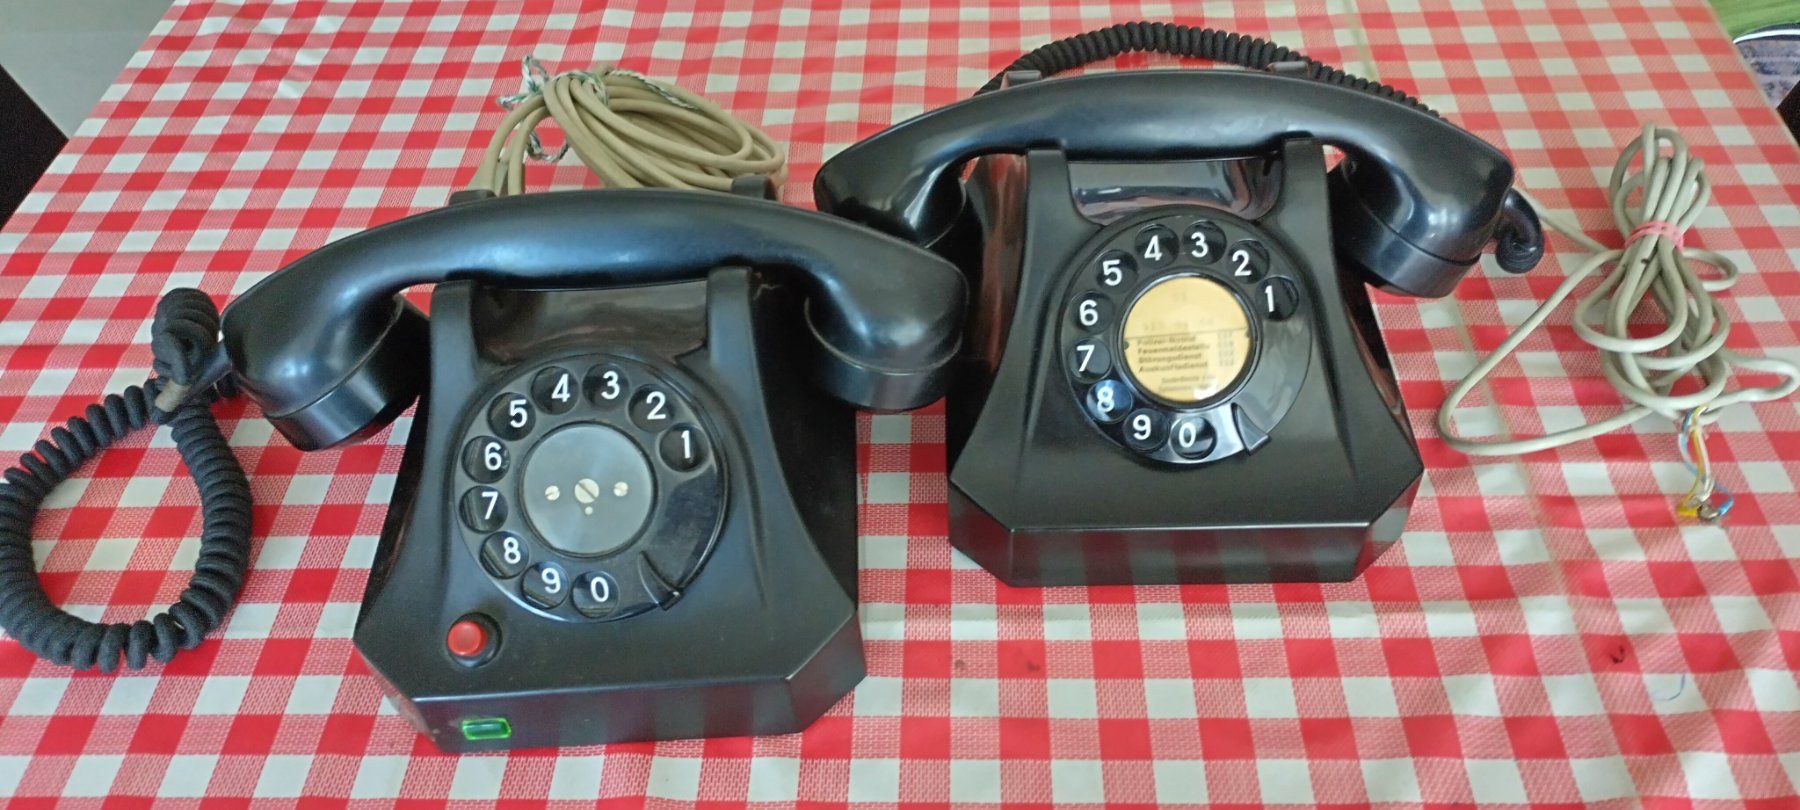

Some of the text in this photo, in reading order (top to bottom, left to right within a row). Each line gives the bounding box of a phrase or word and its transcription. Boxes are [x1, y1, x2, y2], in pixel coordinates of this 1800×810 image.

[1077, 232, 1277, 447] 1 2 3 4 5 6 7 8 9 0
[482, 371, 691, 603] 1 2 3 4 5 6 7 8 9 0
